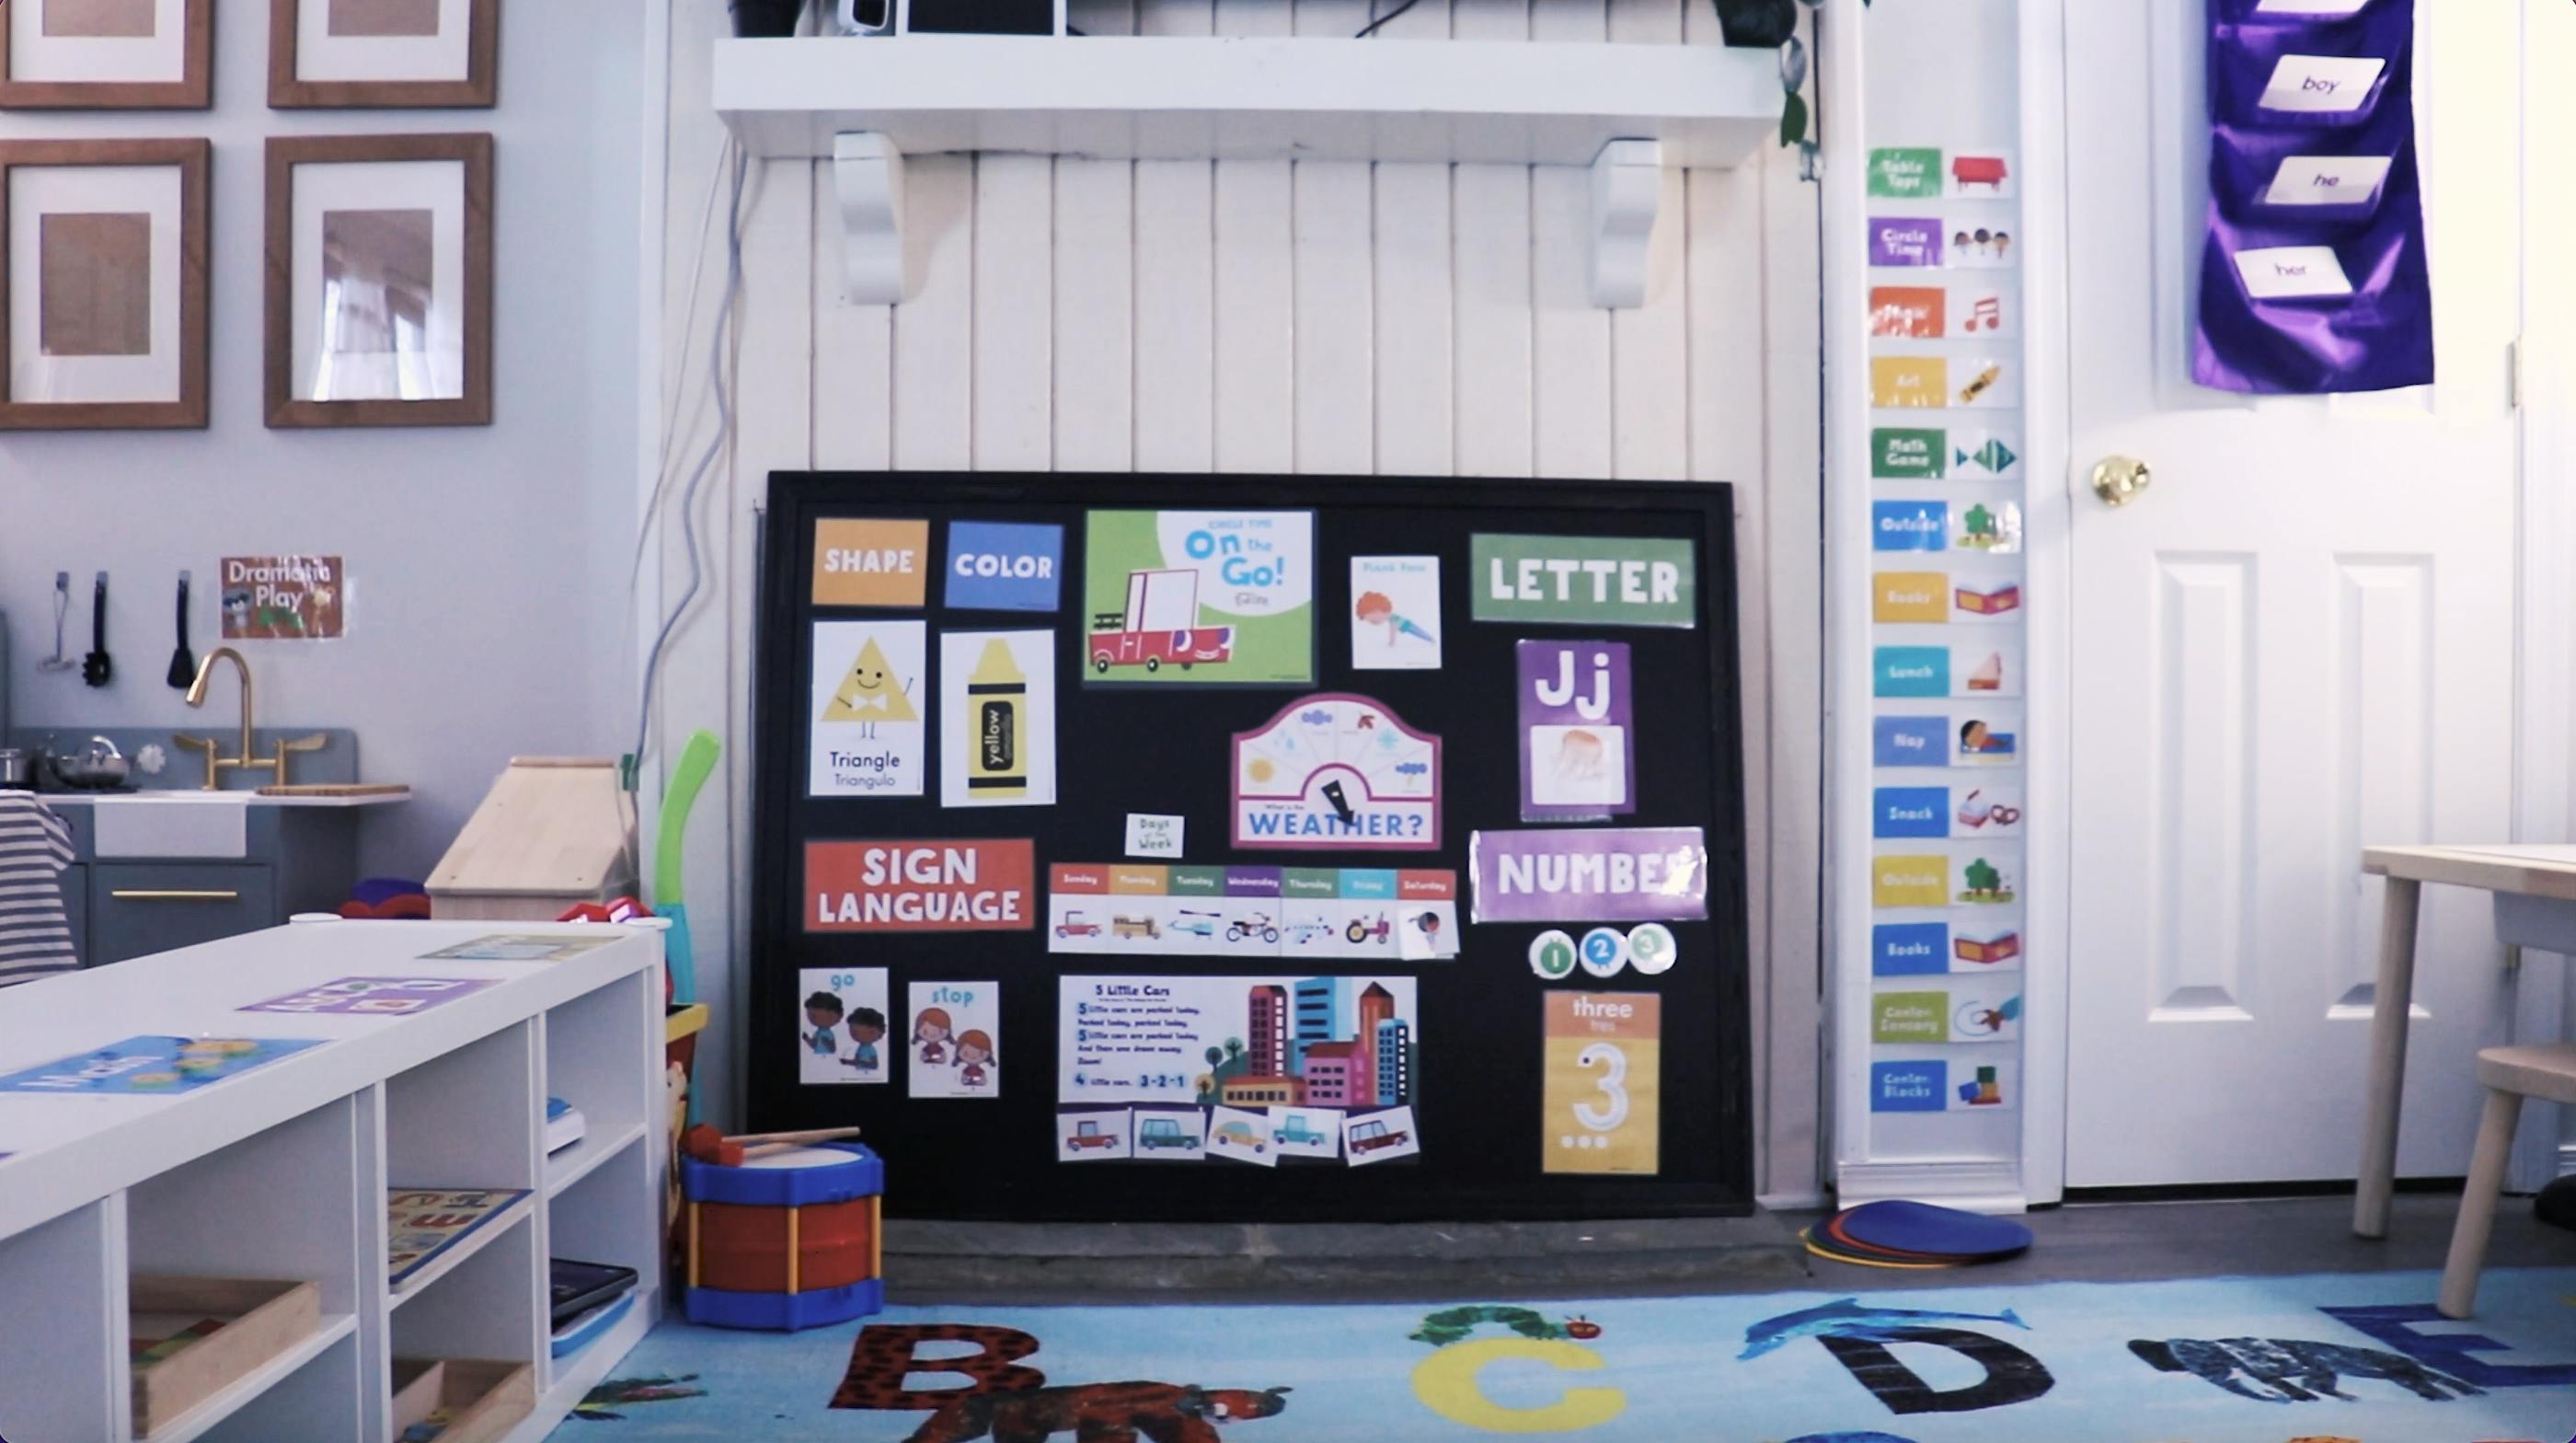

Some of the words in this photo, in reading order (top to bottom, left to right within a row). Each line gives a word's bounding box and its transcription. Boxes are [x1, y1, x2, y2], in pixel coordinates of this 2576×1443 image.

[2301, 75, 2341, 94] boy
[2312, 173, 2340, 187] he
[1880, 228, 1928, 243] Circle
[1887, 242, 1924, 257] Time
[2274, 262, 2307, 276] her
[1888, 438, 1927, 452] Math
[1185, 530, 1241, 560] On
[1248, 538, 1273, 551] the
[823, 548, 915, 574] SHAPE
[954, 553, 1053, 579] COLOR
[1221, 556, 1284, 586] Go!
[1489, 557, 1680, 605] LETTER
[255, 583, 304, 614] Play
[1888, 664, 1934, 678] Lunch
[984, 710, 1005, 765] yellow
[1892, 733, 1926, 748] Nap
[829, 751, 901, 772] Triangle
[834, 773, 896, 789] Triangulo
[1889, 806, 1934, 820] Snack
[1140, 818, 1169, 831] Days
[1248, 812, 1424, 837] WEATHER?
[1138, 838, 1171, 848] Week
[861, 848, 977, 886] SIGN
[1063, 873, 1098, 885] Sunday
[1175, 875, 1214, 887] Tuesday
[1226, 876, 1280, 889] Wednesday
[1288, 878, 1332, 891] Thursday
[1403, 880, 1447, 893] Saturday
[818, 890, 1021, 923] LANGUAGE
[1551, 948, 1559, 968] 1
[1593, 939, 1610, 958] 2
[1639, 934, 1655, 952] 3
[1887, 942, 1931, 956] Books
[830, 974, 856, 991] go
[931, 987, 974, 1008] stop
[1096, 985, 1103, 996] 5
[1144, 985, 1170, 996] Cars
[1078, 1002, 1087, 1015] 5
[1572, 995, 1634, 1018] three
[1590, 1019, 1616, 1032] tres
[1078, 1029, 1087, 1042] 5
[1075, 1073, 1086, 1086] 4
[1572, 1041, 1629, 1132] 3
[1883, 1084, 1931, 1098] Blocks
[828, 1323, 1047, 1409] B
[1410, 1336, 1627, 1433] C
[1815, 1323, 2055, 1414] D
[2315, 1303, 2576, 1387] E
